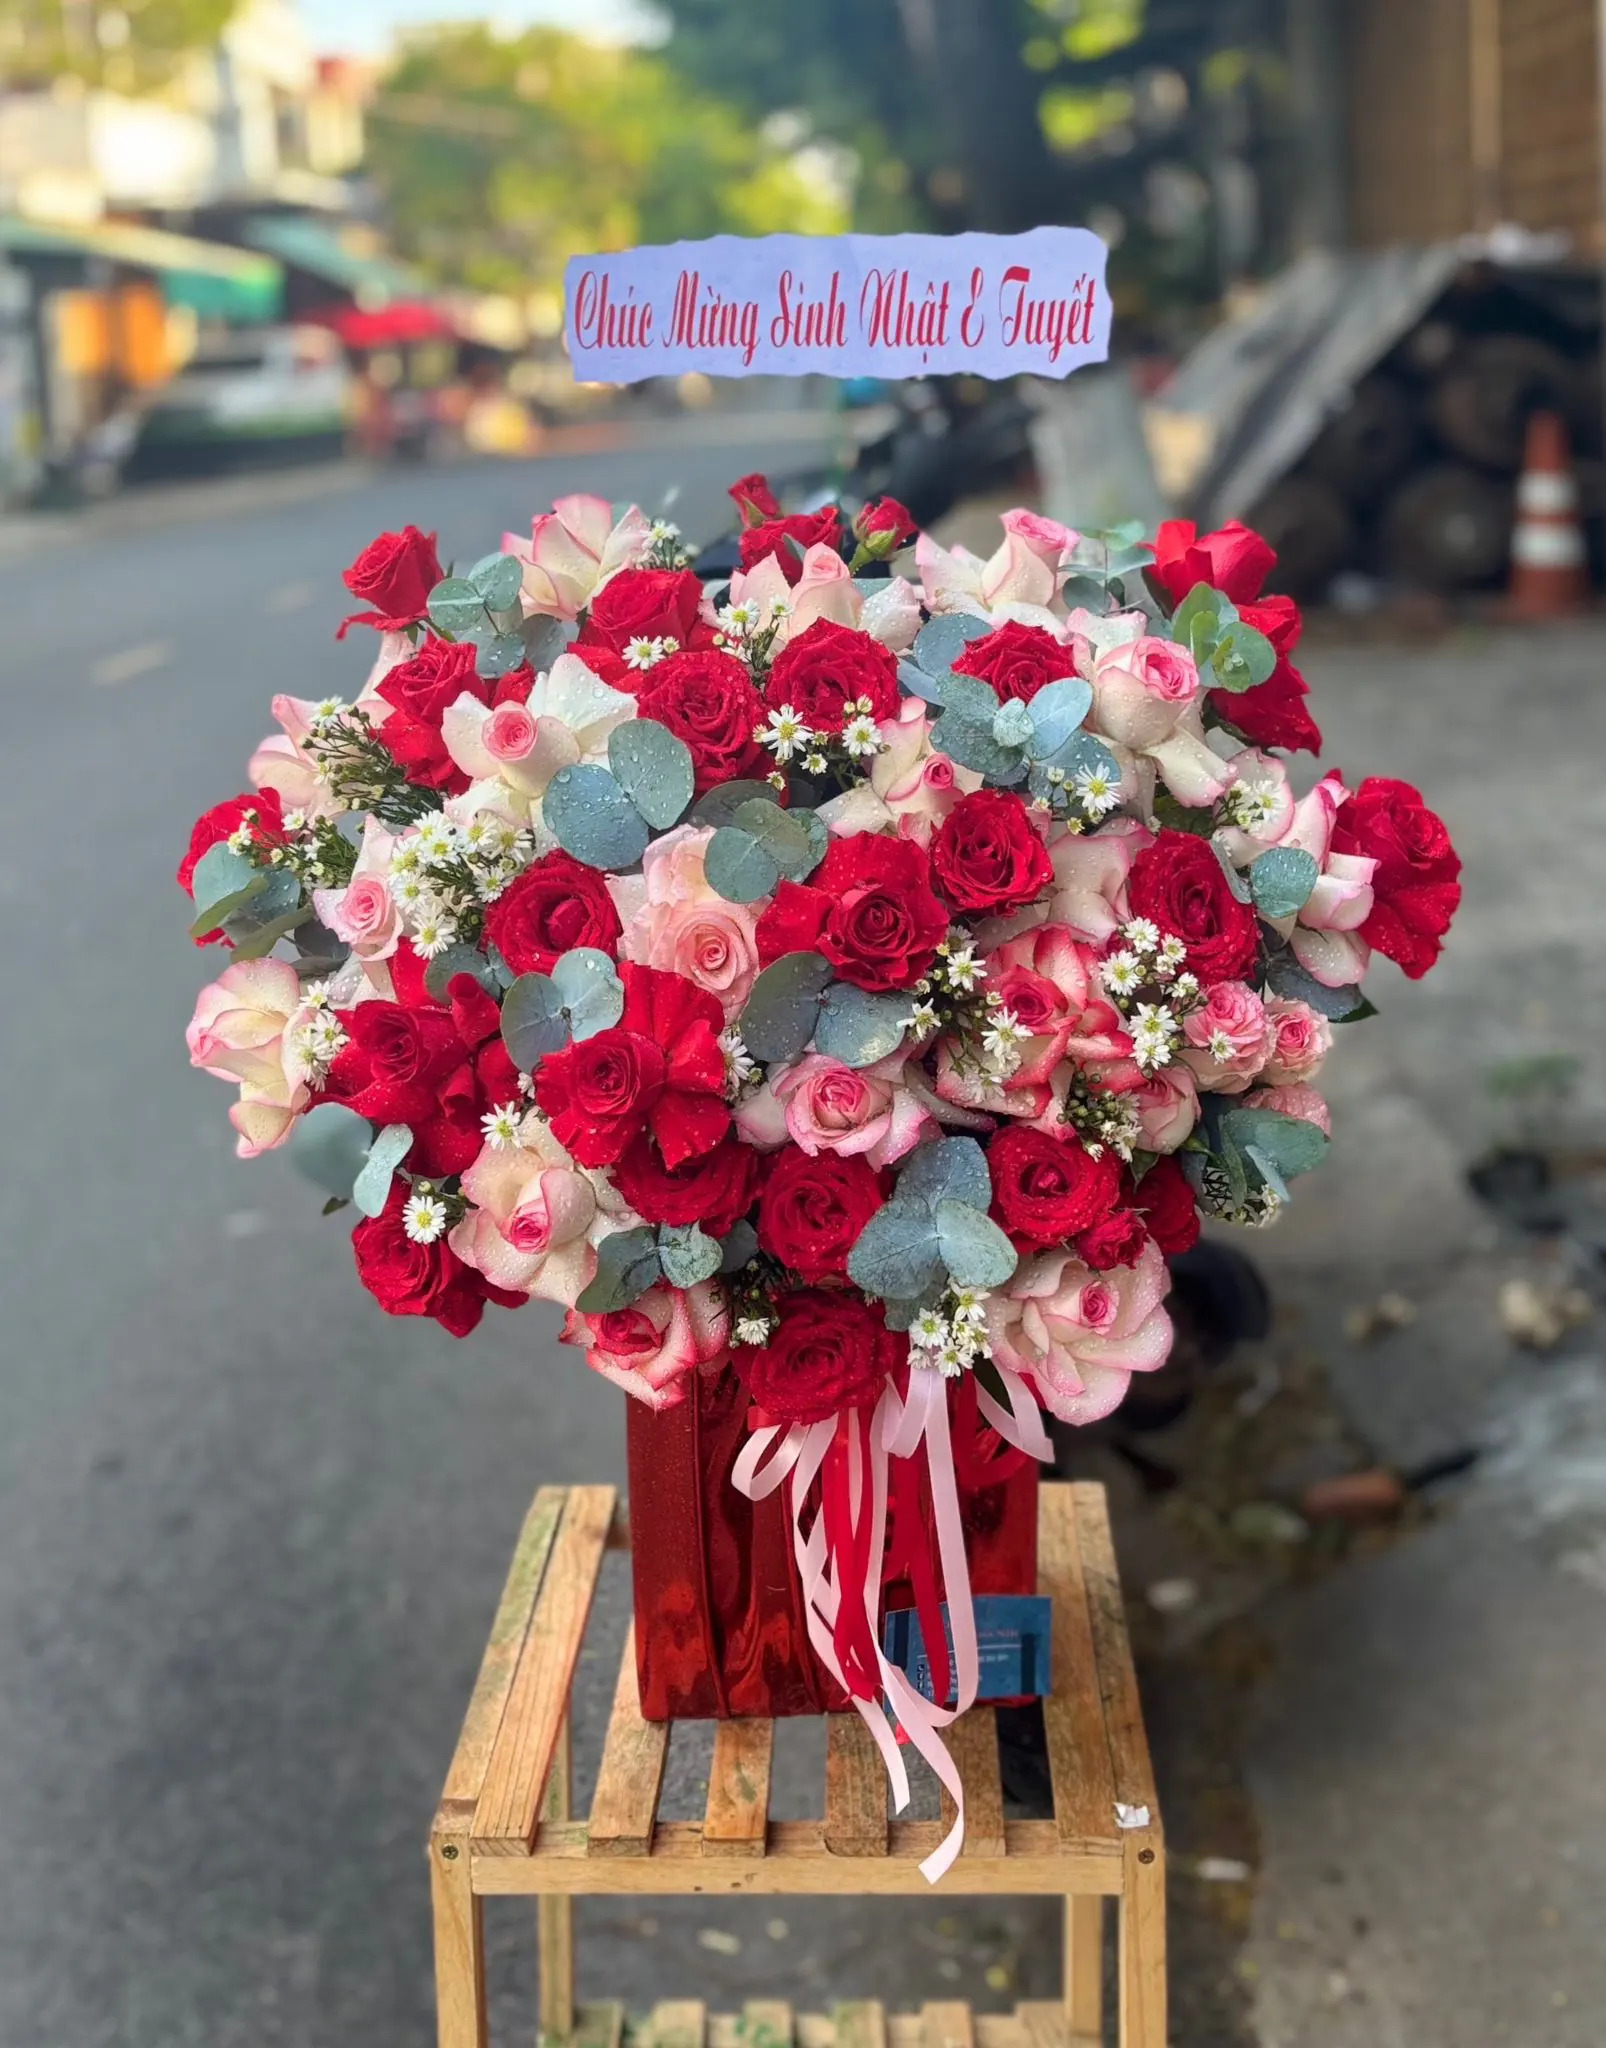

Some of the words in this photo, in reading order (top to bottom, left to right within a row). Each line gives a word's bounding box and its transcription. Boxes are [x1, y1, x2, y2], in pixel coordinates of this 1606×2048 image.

[575, 271, 654, 349] Chúc
[662, 270, 761, 367] Mừng
[770, 270, 848, 348] Sinh
[860, 268, 950, 364] Nhật
[1000, 266, 1095, 363] Tuyết
